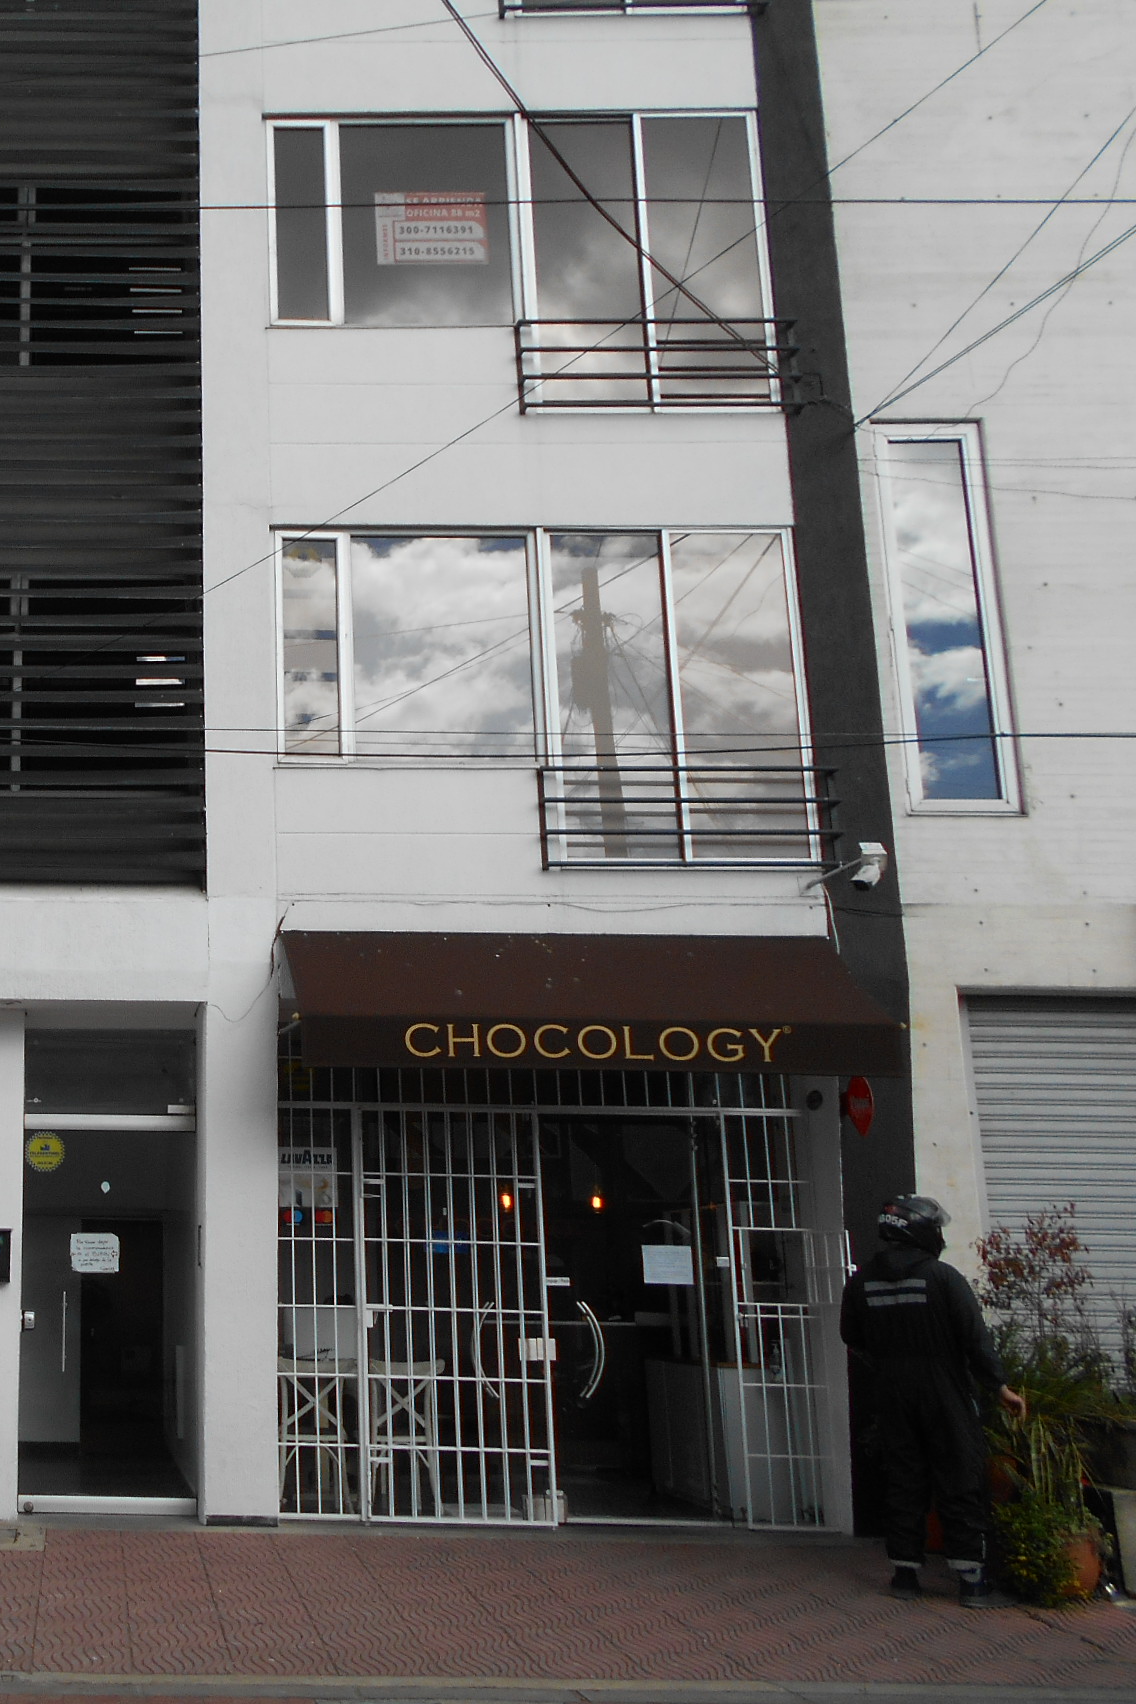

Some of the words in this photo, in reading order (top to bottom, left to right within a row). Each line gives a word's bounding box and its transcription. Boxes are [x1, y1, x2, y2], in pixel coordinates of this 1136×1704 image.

[406, 208, 448, 217] OFICINA
[399, 225, 473, 235] 300-7116391
[400, 247, 475, 256] 310-8556215
[404, 1022, 782, 1063] CHOCOLOGY
